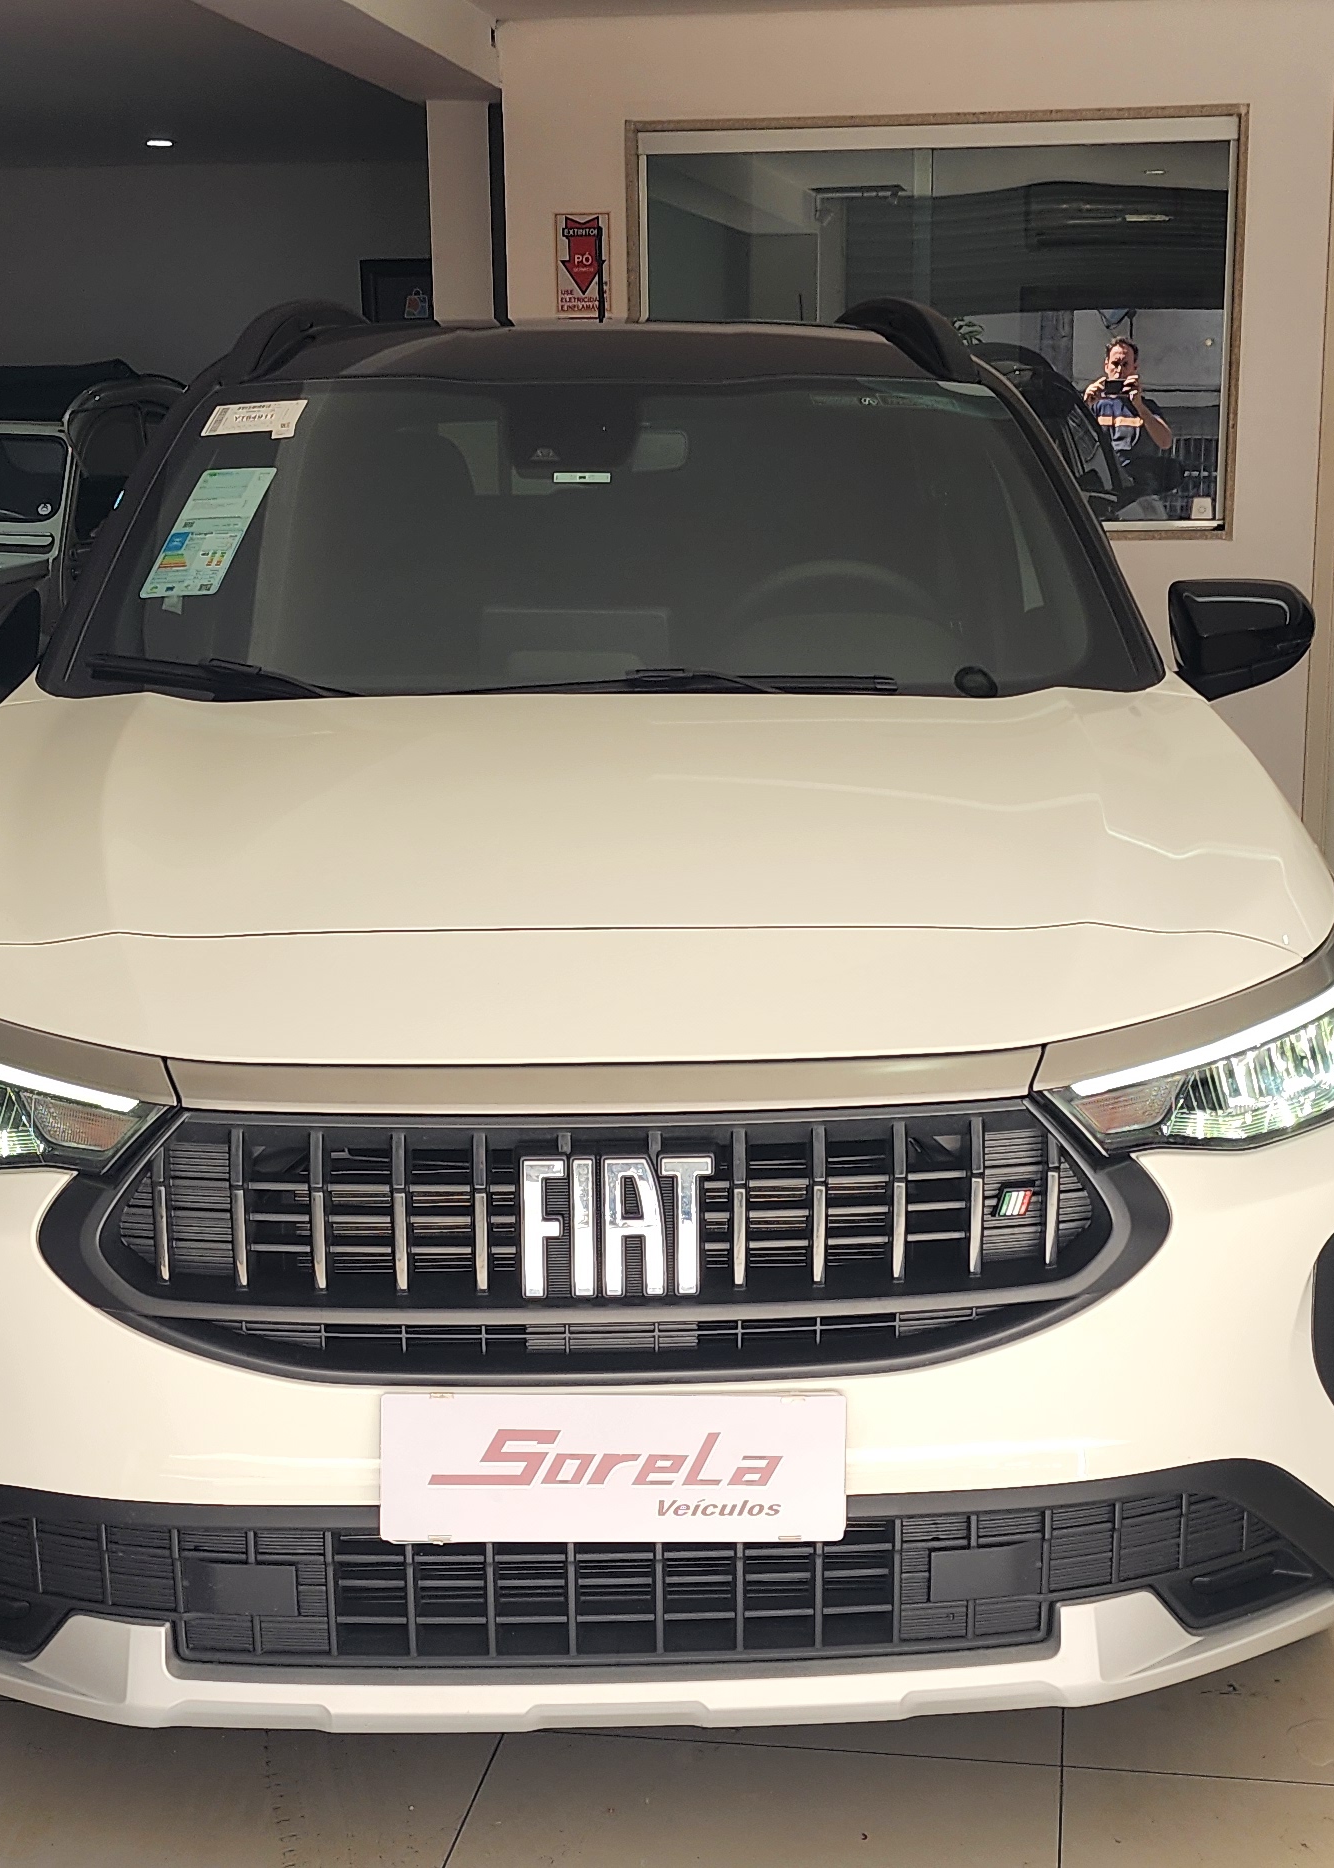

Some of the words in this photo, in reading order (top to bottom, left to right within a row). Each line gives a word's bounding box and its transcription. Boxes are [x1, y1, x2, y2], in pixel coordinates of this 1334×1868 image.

[574, 252, 592, 265] PÓ
[521, 1154, 715, 1298] FIAT
[658, 1499, 781, 1517] Veículos
